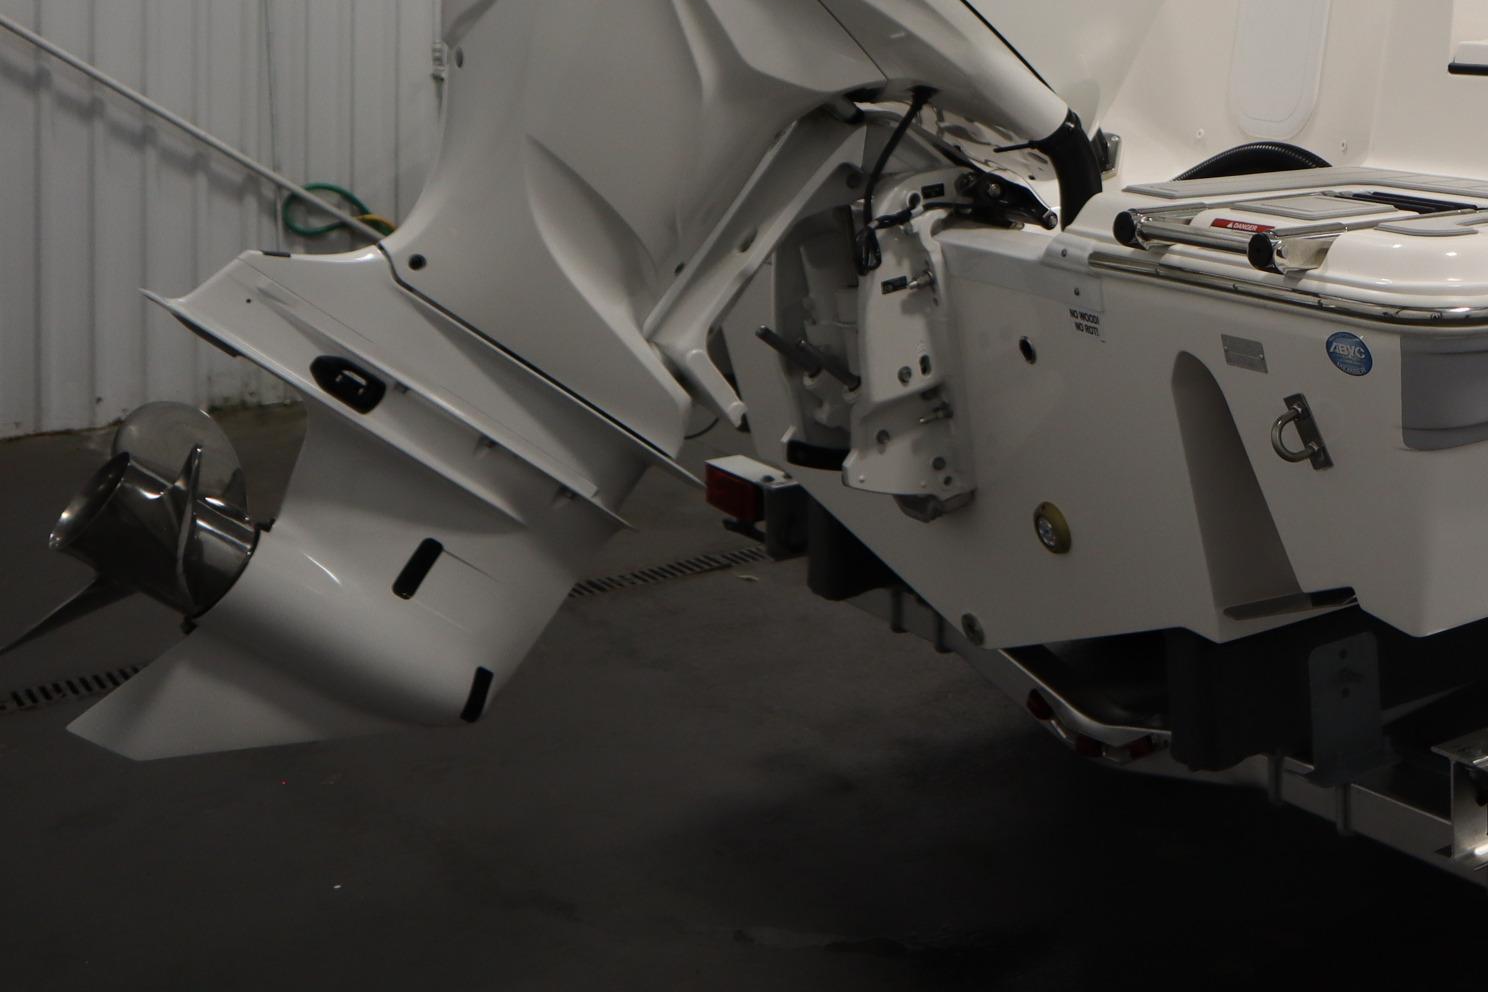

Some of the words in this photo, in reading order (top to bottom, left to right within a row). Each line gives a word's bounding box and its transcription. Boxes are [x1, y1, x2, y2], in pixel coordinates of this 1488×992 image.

[1233, 222, 1258, 231] DANGER
[1069, 308, 1079, 319] NO
[1074, 321, 1084, 332] NO
[1329, 341, 1366, 359] ABYC
